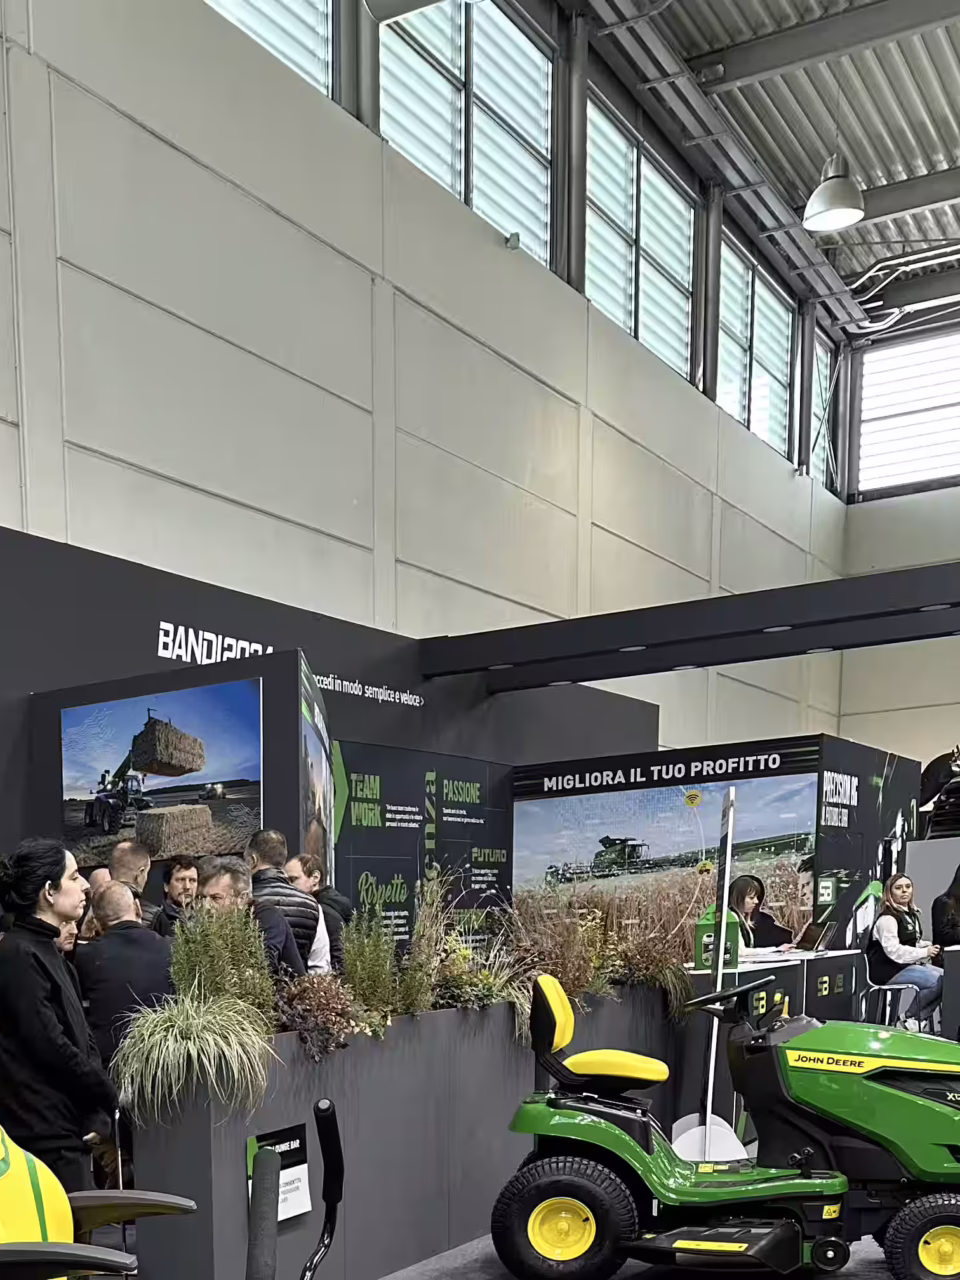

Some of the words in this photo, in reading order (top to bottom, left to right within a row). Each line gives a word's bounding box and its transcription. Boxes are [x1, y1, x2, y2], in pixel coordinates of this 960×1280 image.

[334, 675, 342, 692] in
[343, 680, 363, 696] modo
[364, 685, 395, 704] semplice
[395, 691, 400, 703] e
[400, 690, 420, 707] veloce
[543, 769, 626, 792] MIGLIORA
[630, 768, 646, 783] IL
[650, 763, 686, 781] TUO
[690, 753, 782, 777] PROFITTO
[350, 772, 380, 799] TEAM
[443, 779, 481, 804] PASSIONE
[350, 801, 382, 827] WORK
[471, 847, 507, 863] FUTURO
[794, 1054, 825, 1065] JOHN
[826, 1057, 865, 1068] DEERE
[290, 1139, 301, 1150] BAR
